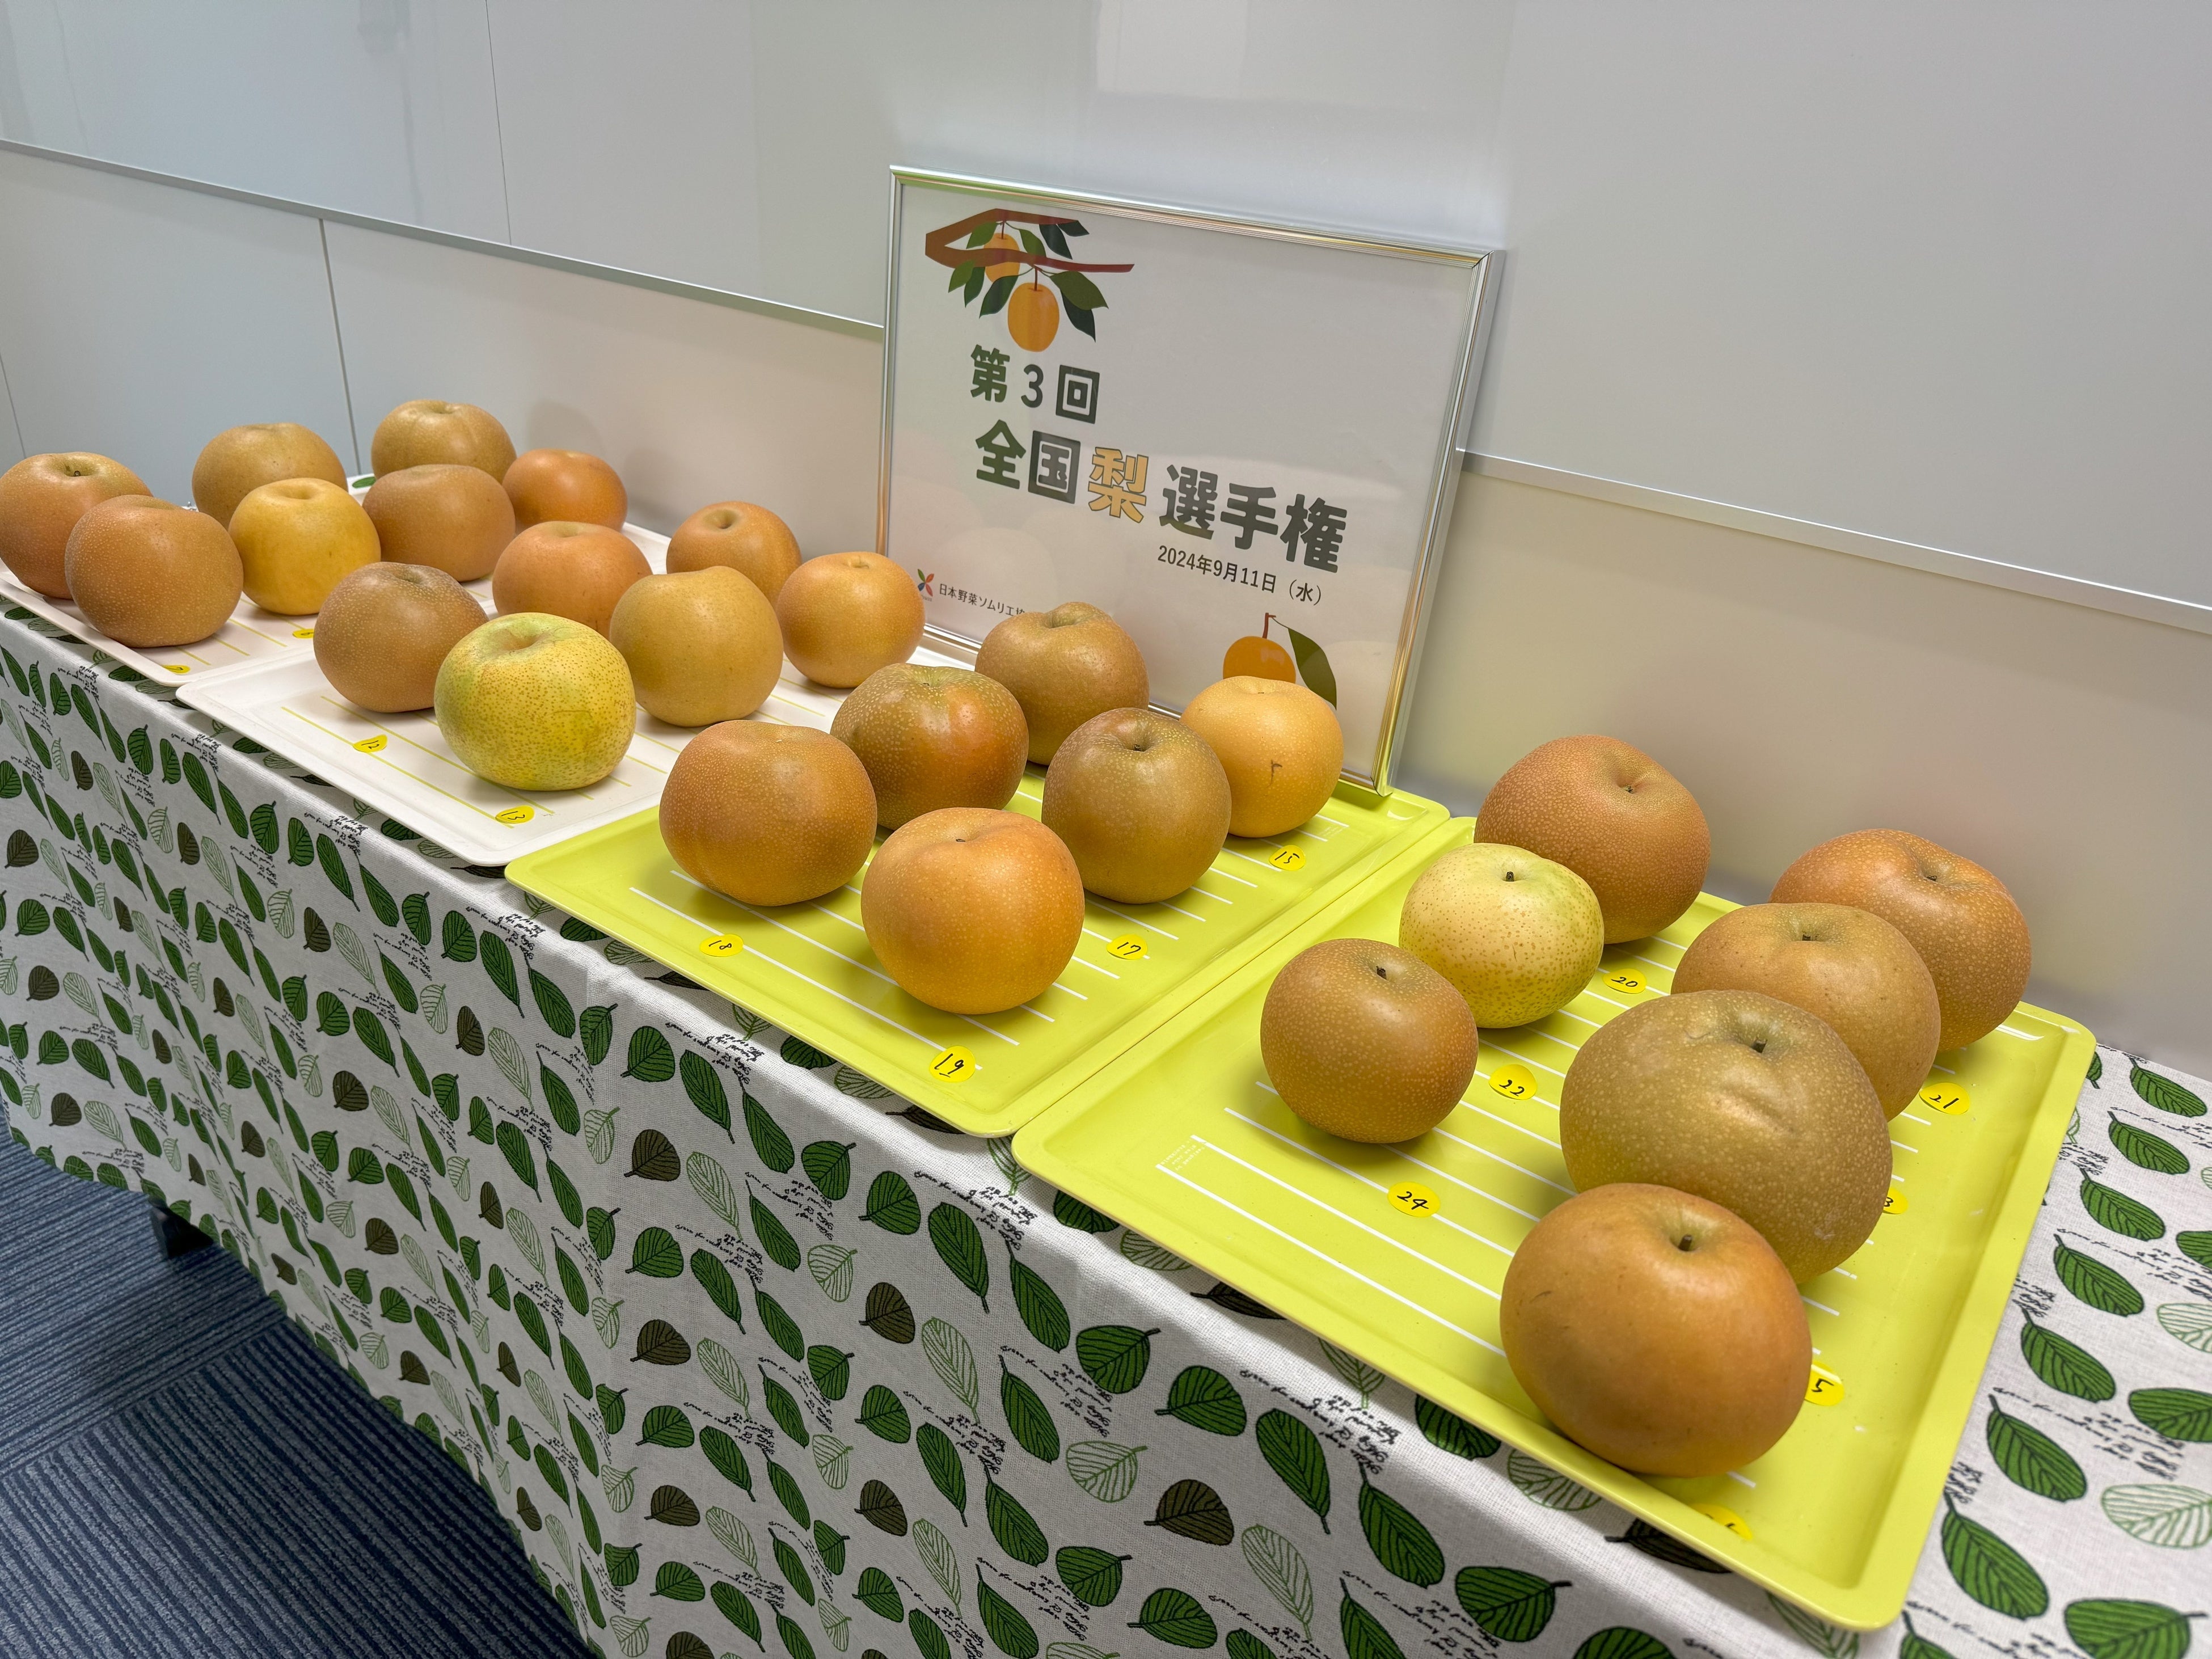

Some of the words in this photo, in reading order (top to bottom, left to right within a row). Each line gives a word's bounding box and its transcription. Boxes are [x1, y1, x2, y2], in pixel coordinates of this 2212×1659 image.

[970, 344, 1100, 424] 第3回
[975, 419, 1348, 573] 全国梨選手権
[361, 740, 380, 750] 12
[501, 810, 525, 820] 13
[1274, 851, 1300, 864] 15
[708, 940, 732, 950] 18
[1116, 942, 1142, 956] 17
[1610, 976, 1639, 988] 20
[934, 1053, 965, 1078] 19
[1498, 1079, 1526, 1096] 22
[1928, 1094, 1960, 1109] 21
[1396, 1191, 1429, 1210] 24
